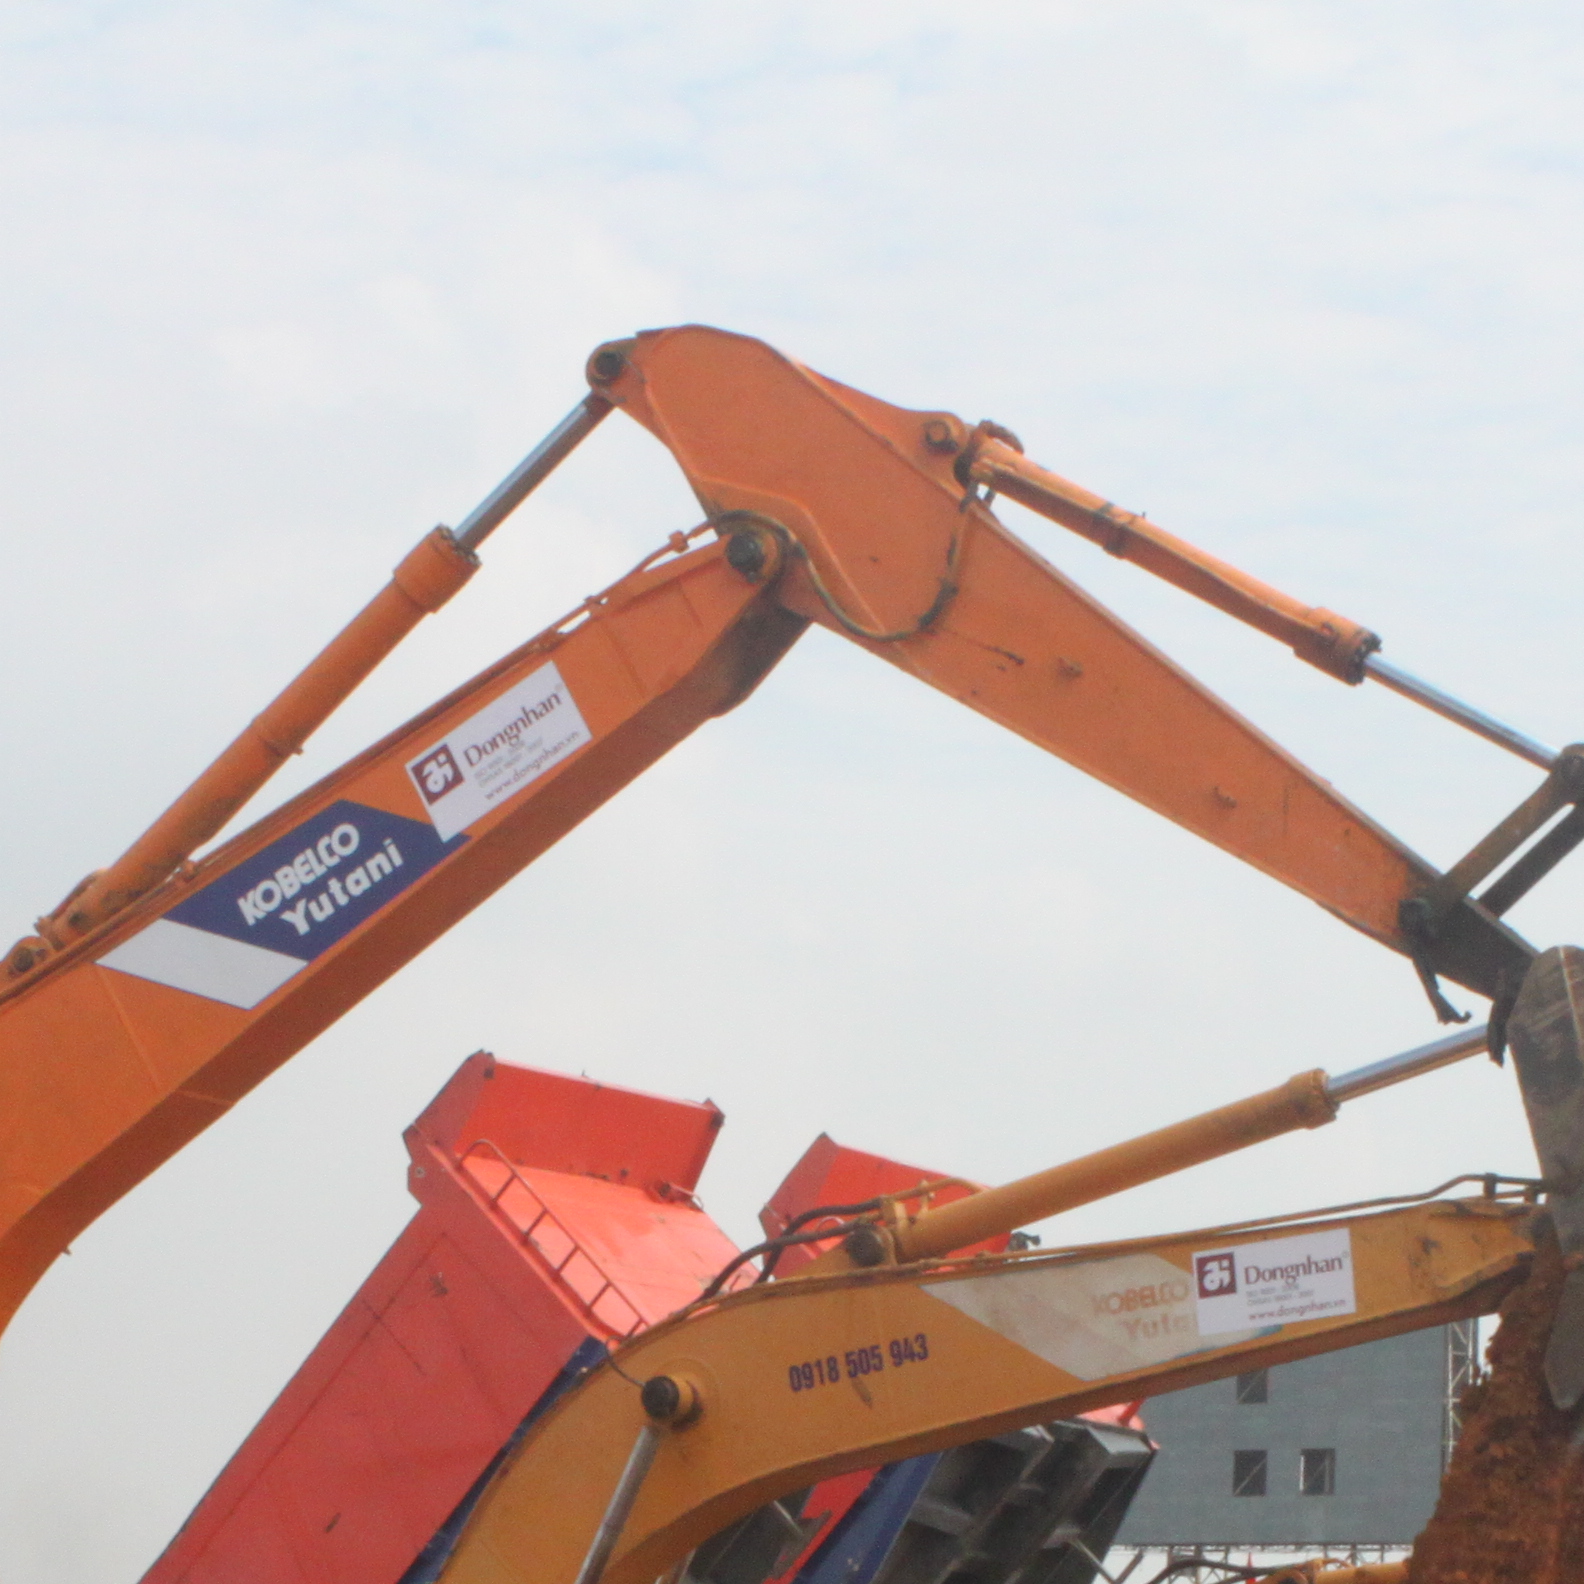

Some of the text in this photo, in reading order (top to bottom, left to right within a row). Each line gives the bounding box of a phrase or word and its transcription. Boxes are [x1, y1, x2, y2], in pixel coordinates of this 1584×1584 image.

[237, 823, 360, 926] KOBELCO
[279, 838, 403, 936] Yutani
[789, 1333, 929, 1392] 0918 505 943
